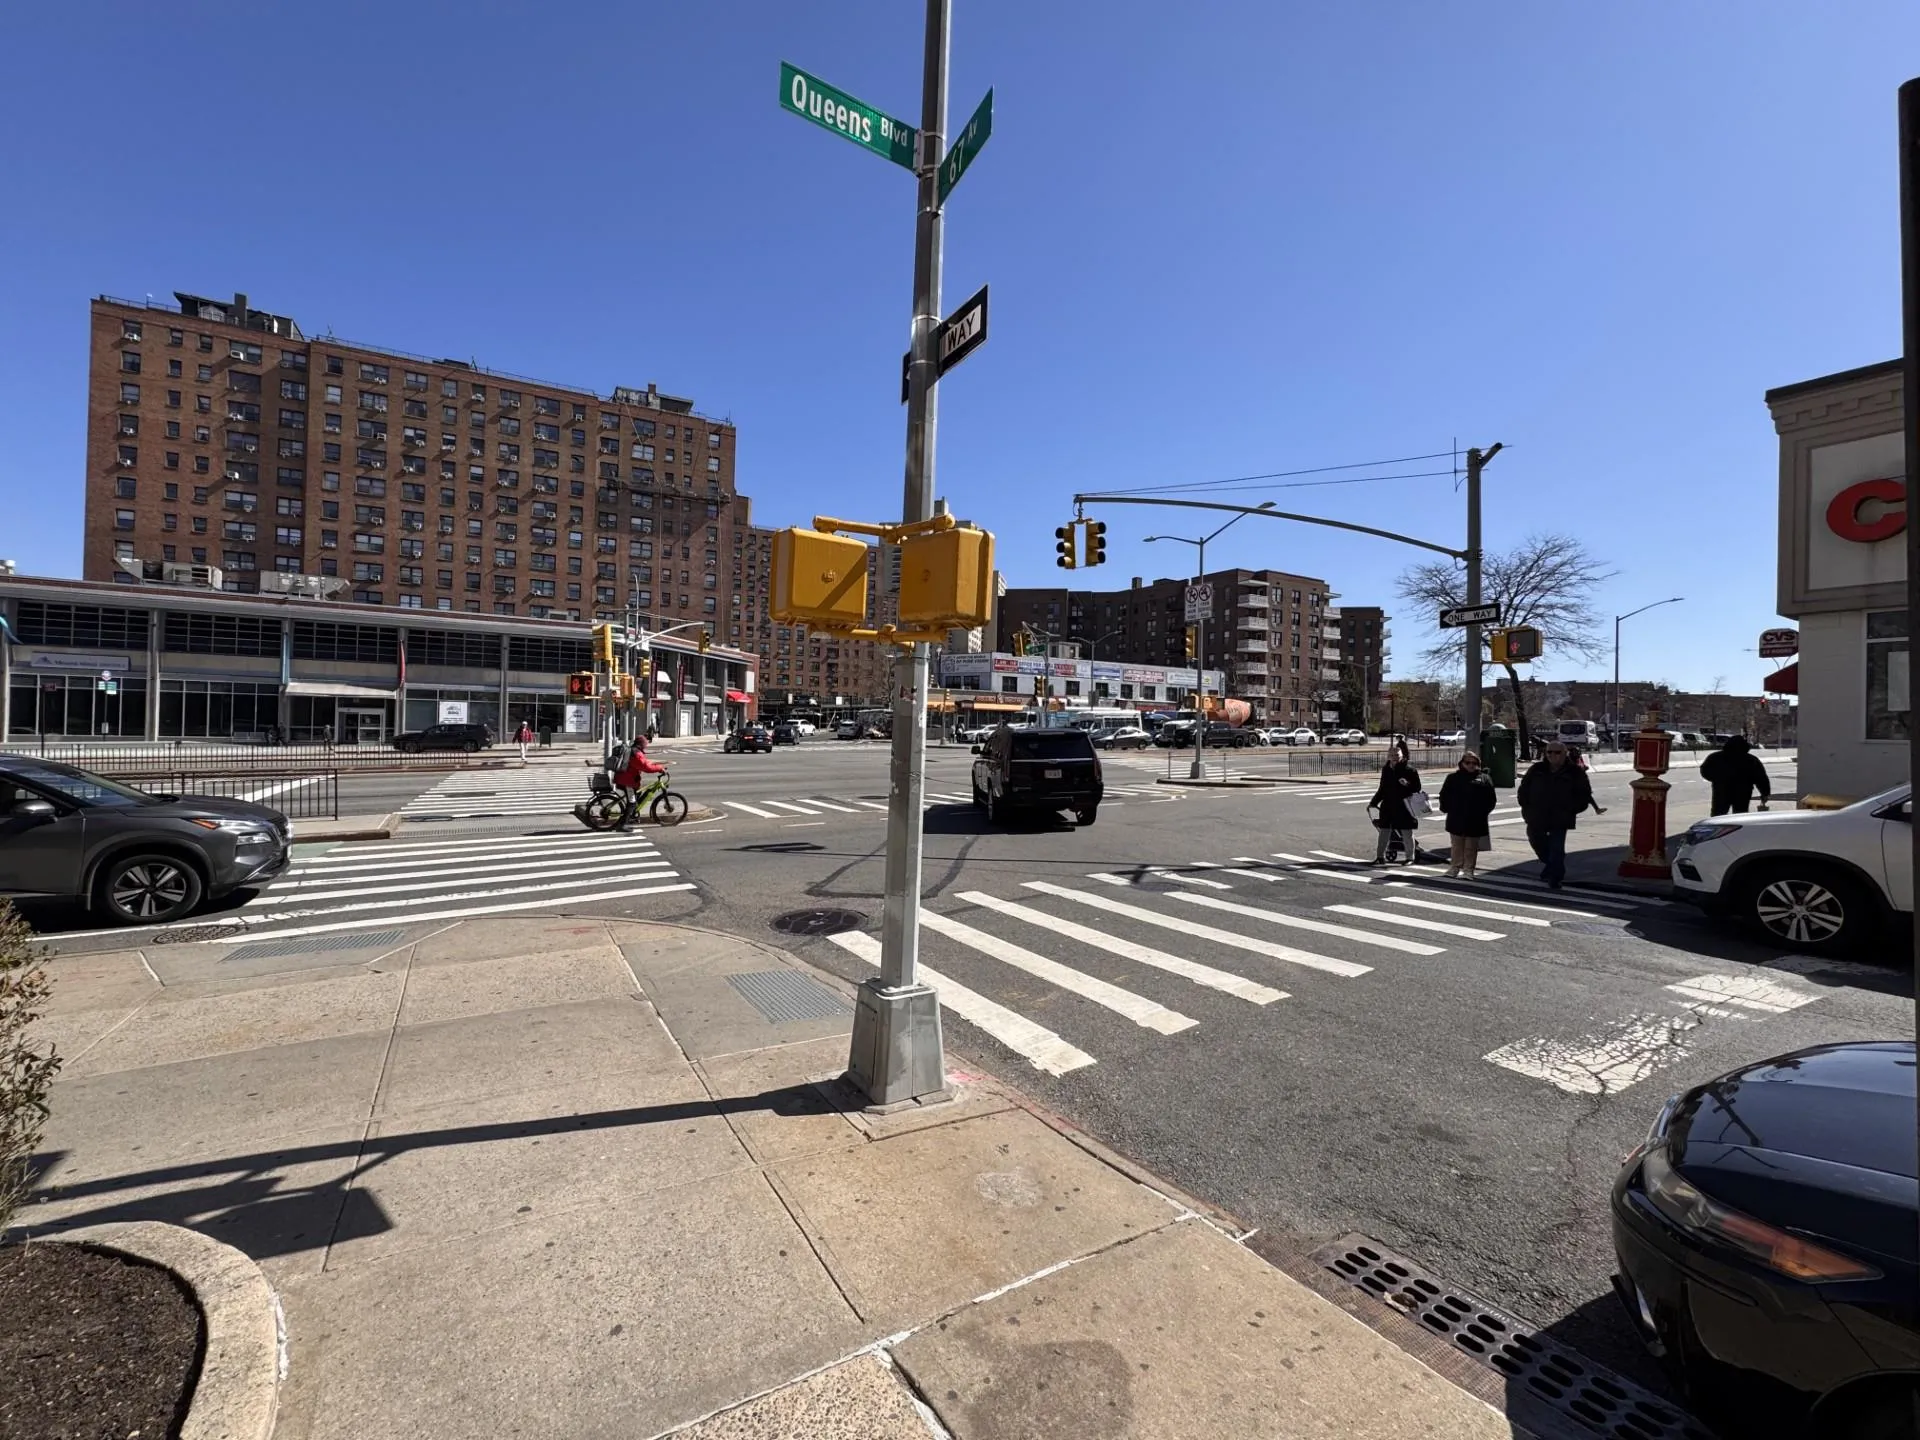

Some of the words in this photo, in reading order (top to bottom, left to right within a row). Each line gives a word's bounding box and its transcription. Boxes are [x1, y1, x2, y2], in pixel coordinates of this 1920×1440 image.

[791, 74, 872, 142] Queens
[880, 117, 908, 147] Blvd
[948, 143, 965, 184] 67
[967, 118, 979, 143] Av
[947, 311, 977, 353] WAY
[1448, 613, 1465, 623] ONE
[1473, 610, 1492, 619] WAY
[1763, 632, 1795, 641] CVS
